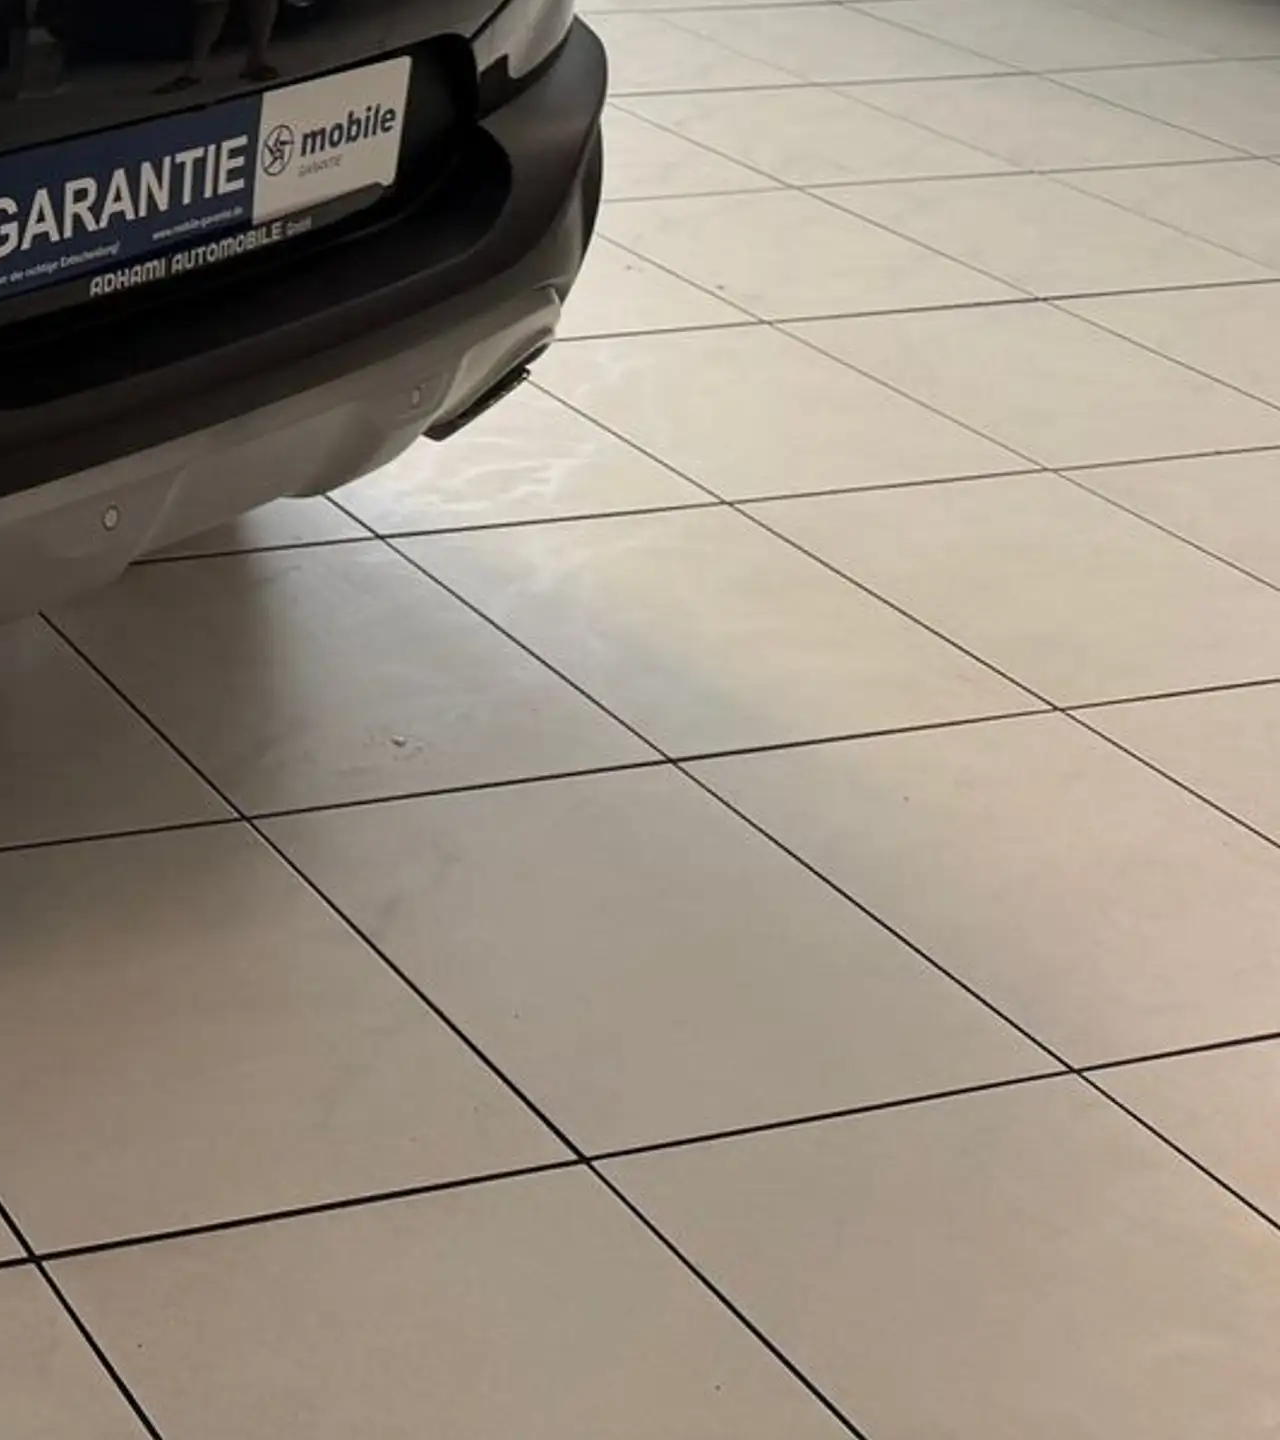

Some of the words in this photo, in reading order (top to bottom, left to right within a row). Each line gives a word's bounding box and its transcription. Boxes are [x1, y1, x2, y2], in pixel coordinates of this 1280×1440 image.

[300, 103, 397, 157] mobile
[89, 258, 167, 298] ADHAMI
[171, 221, 283, 275] AUTOMOBILE
